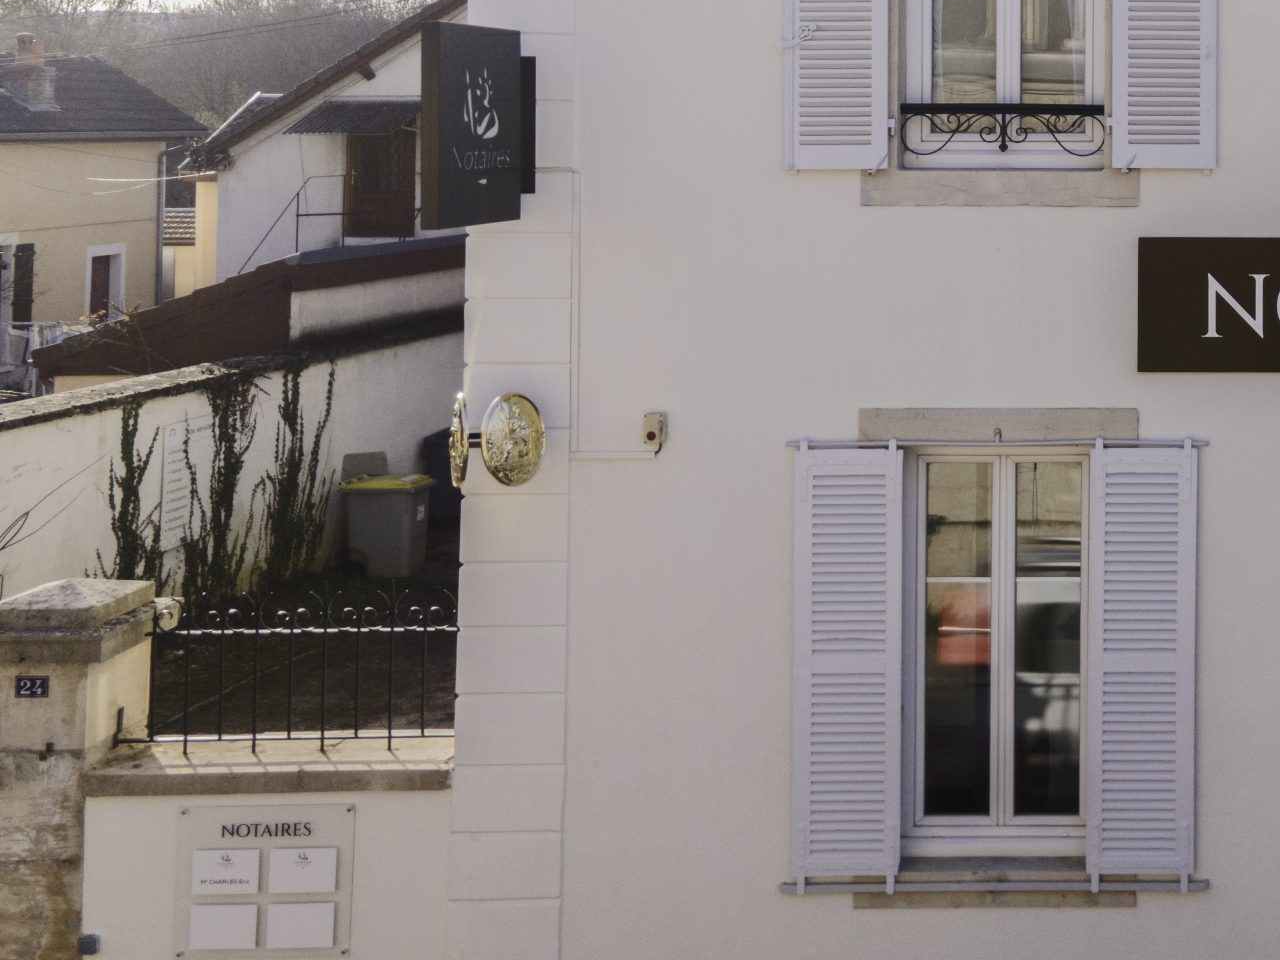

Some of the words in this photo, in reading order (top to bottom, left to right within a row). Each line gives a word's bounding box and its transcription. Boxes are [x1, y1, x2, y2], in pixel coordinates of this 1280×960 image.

[452, 144, 511, 169] Notaires
[20, 679, 43, 695] 24
[221, 822, 312, 838] NOTAIRES
